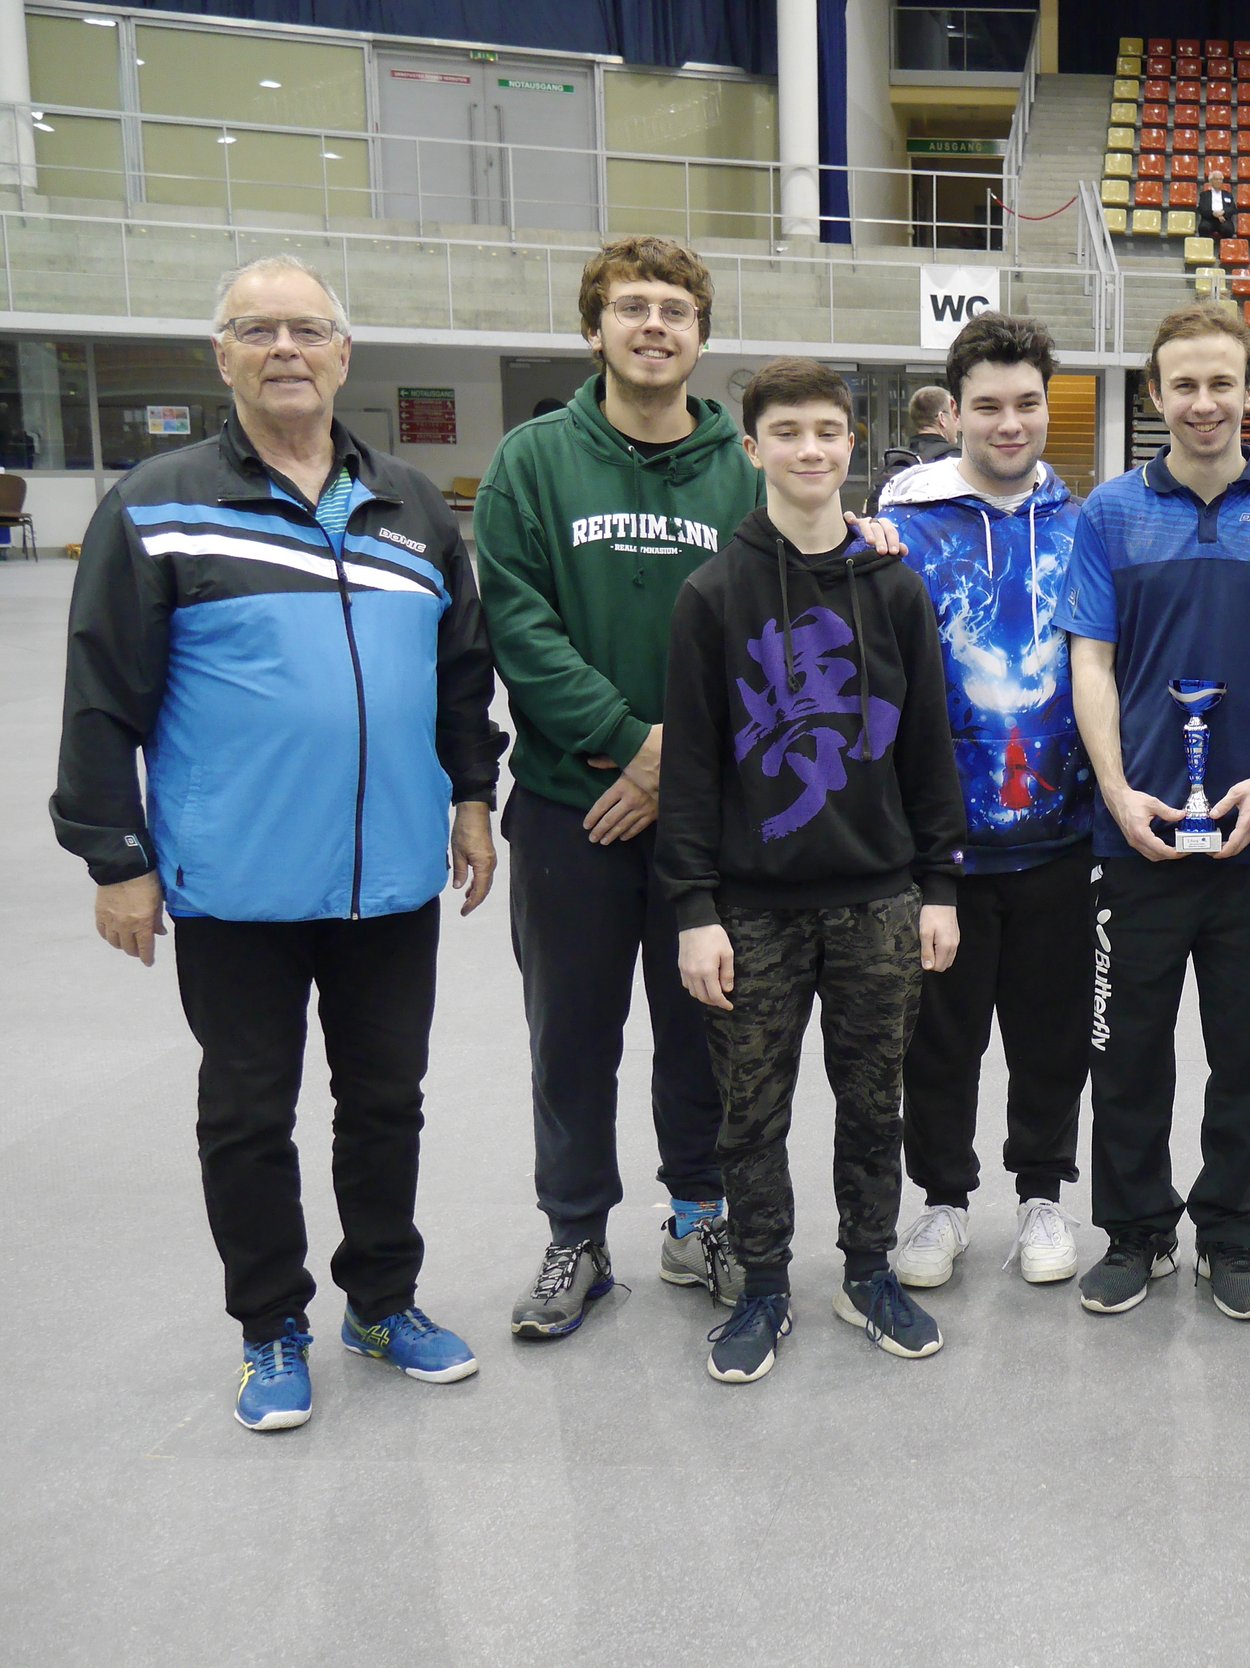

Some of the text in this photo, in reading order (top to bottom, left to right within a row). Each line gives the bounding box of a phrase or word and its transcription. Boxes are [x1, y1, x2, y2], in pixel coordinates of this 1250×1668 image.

[509, 80, 564, 92] NOTAUSGANG
[929, 142, 981, 152] AUSGANG
[930, 294, 990, 322] WC
[1091, 948, 1112, 1052] Butterfly
